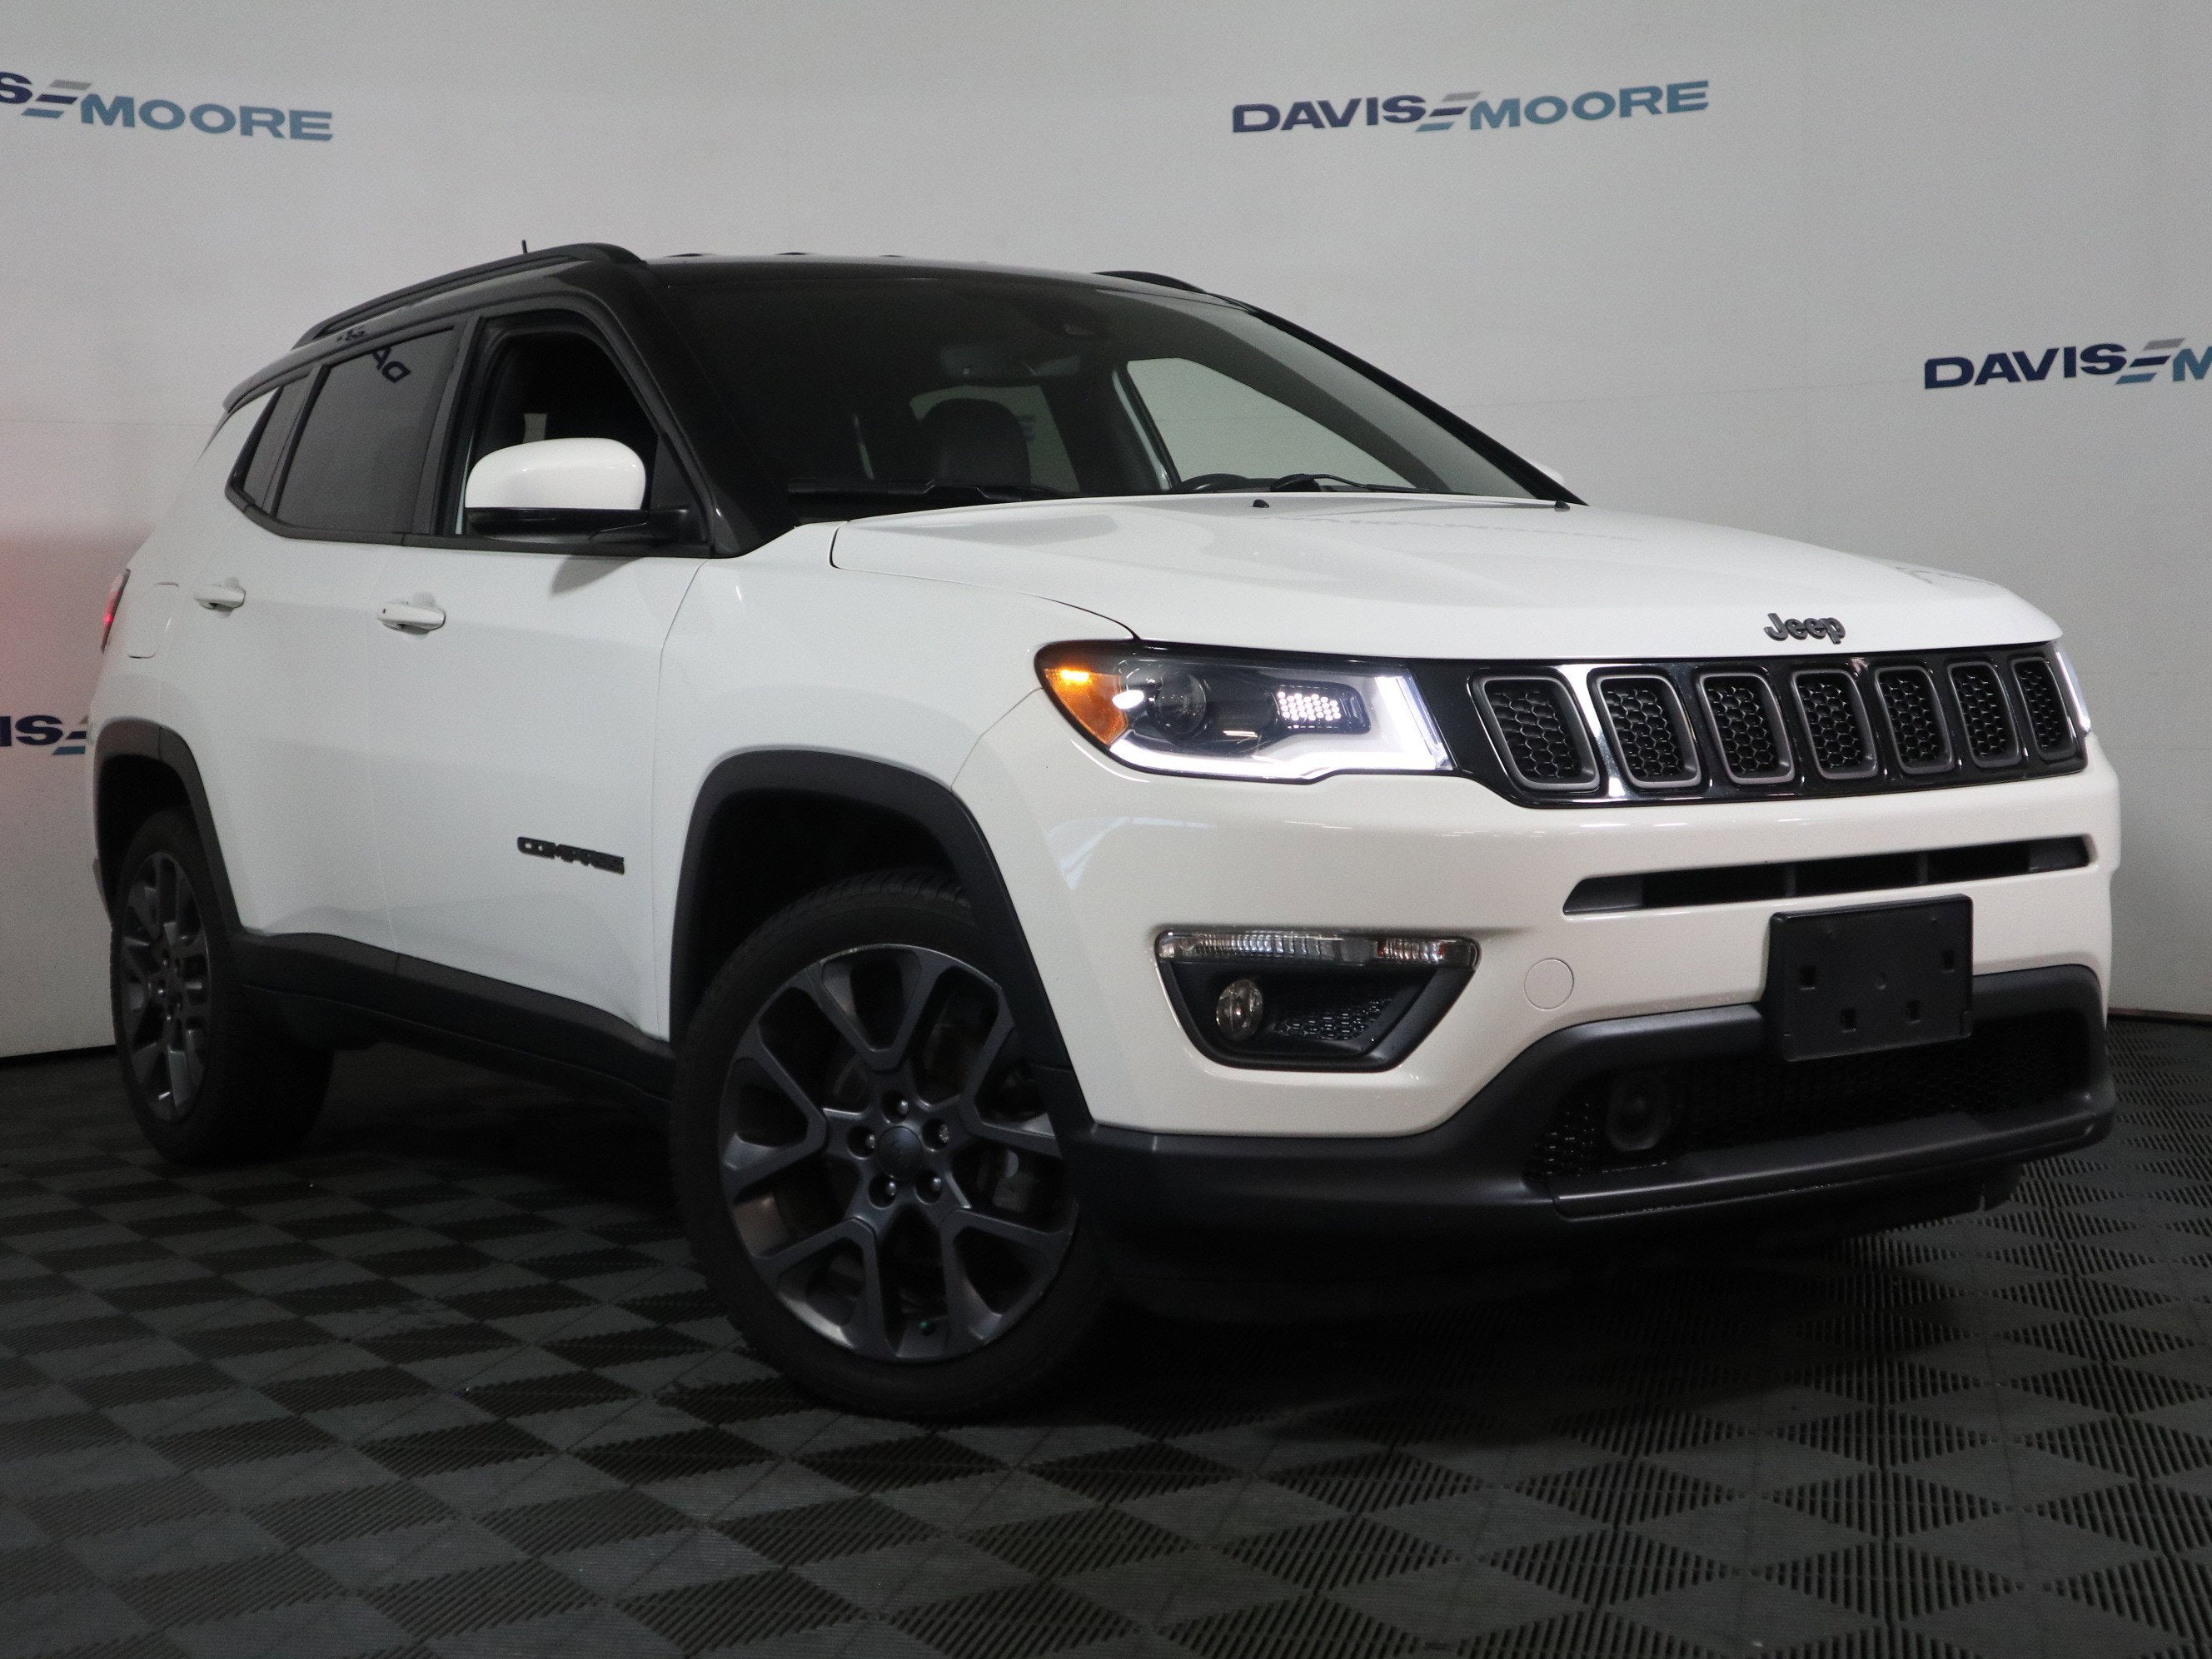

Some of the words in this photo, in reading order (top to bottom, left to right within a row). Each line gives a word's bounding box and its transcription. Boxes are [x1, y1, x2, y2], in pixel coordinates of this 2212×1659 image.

[80, 92, 333, 142] MOORE
[1232, 95, 1427, 133] DAVIS
[1470, 80, 1709, 130] MOORE
[1924, 343, 2127, 390] DAVIS
[1763, 612, 1846, 645] Jeep
